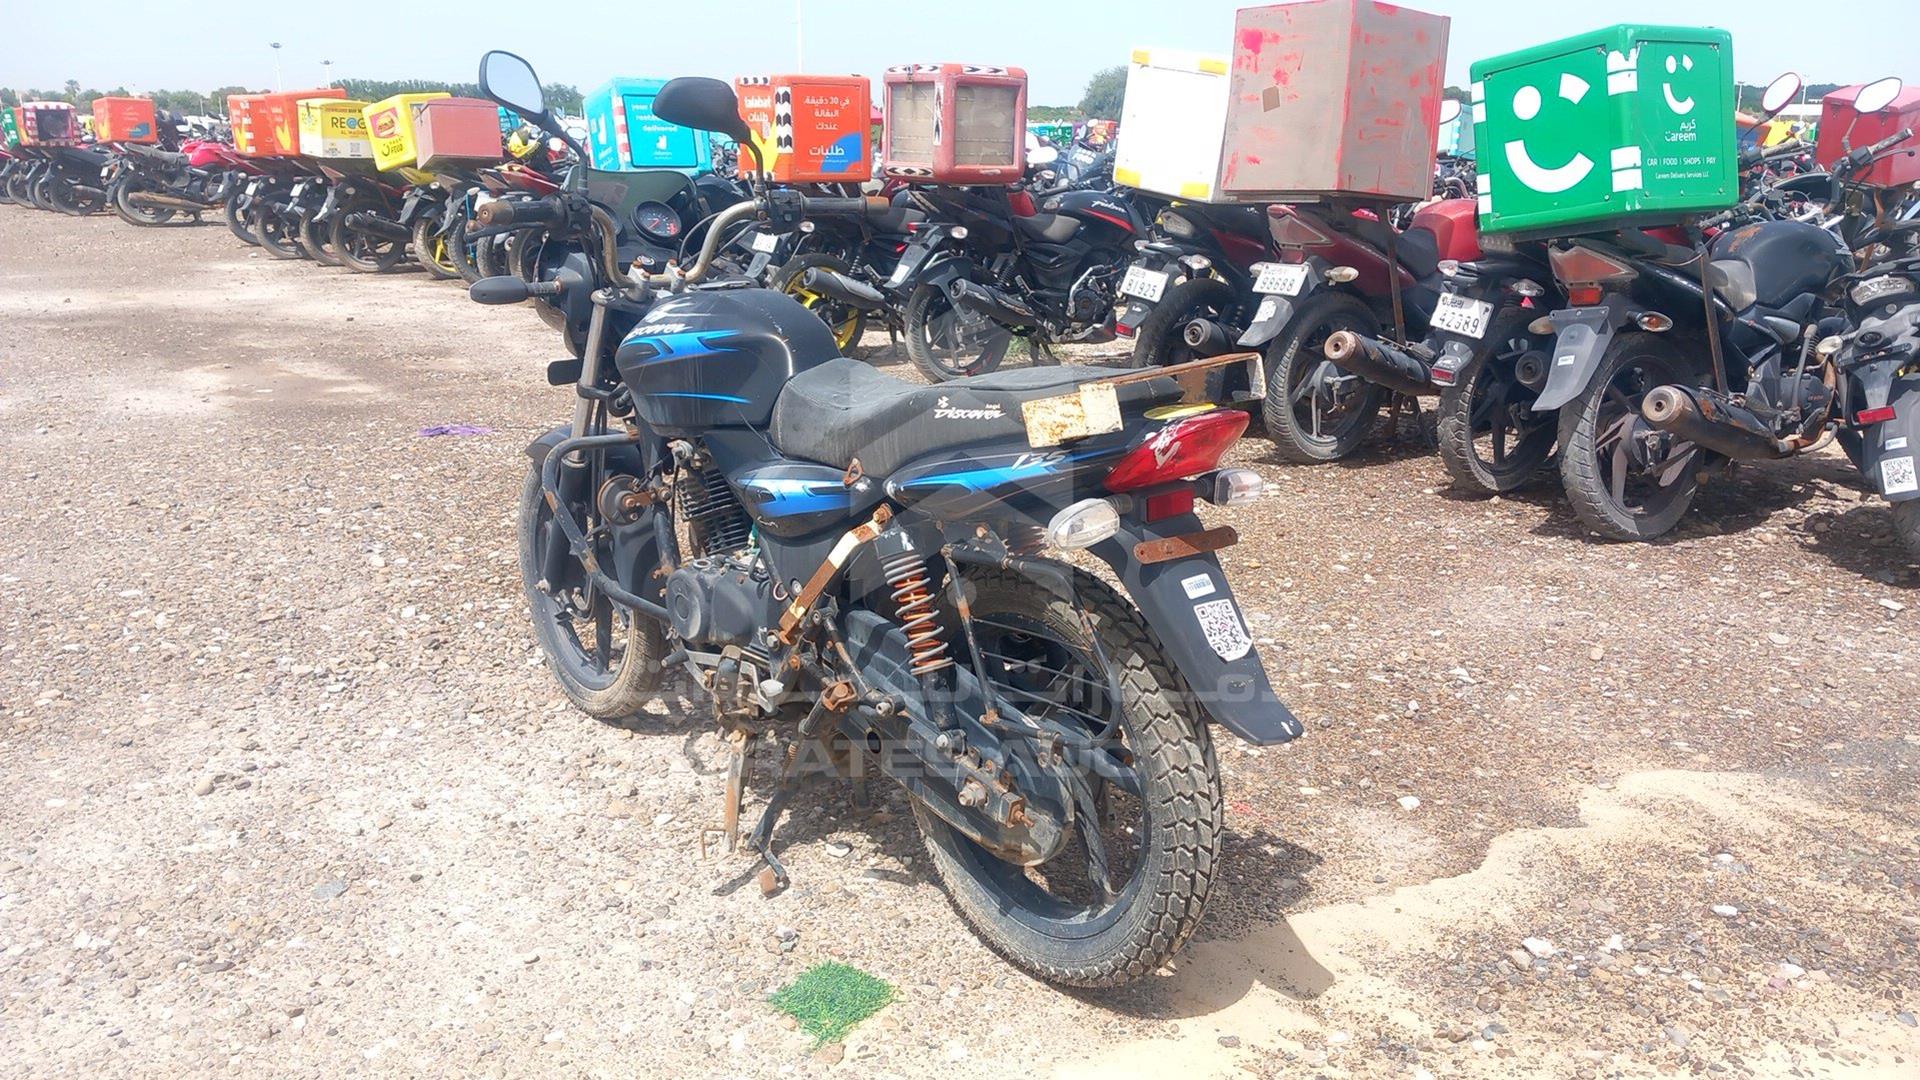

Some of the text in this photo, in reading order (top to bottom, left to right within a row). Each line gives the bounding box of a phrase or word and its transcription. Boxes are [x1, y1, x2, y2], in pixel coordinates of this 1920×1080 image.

[1679, 118, 1697, 131] كريم
[1664, 130, 1697, 142] Careem
[808, 145, 845, 159] طلبات
[1646, 156, 1717, 167] CAR FOOD SHOPS PAY
[934, 407, 1007, 420] Discover
